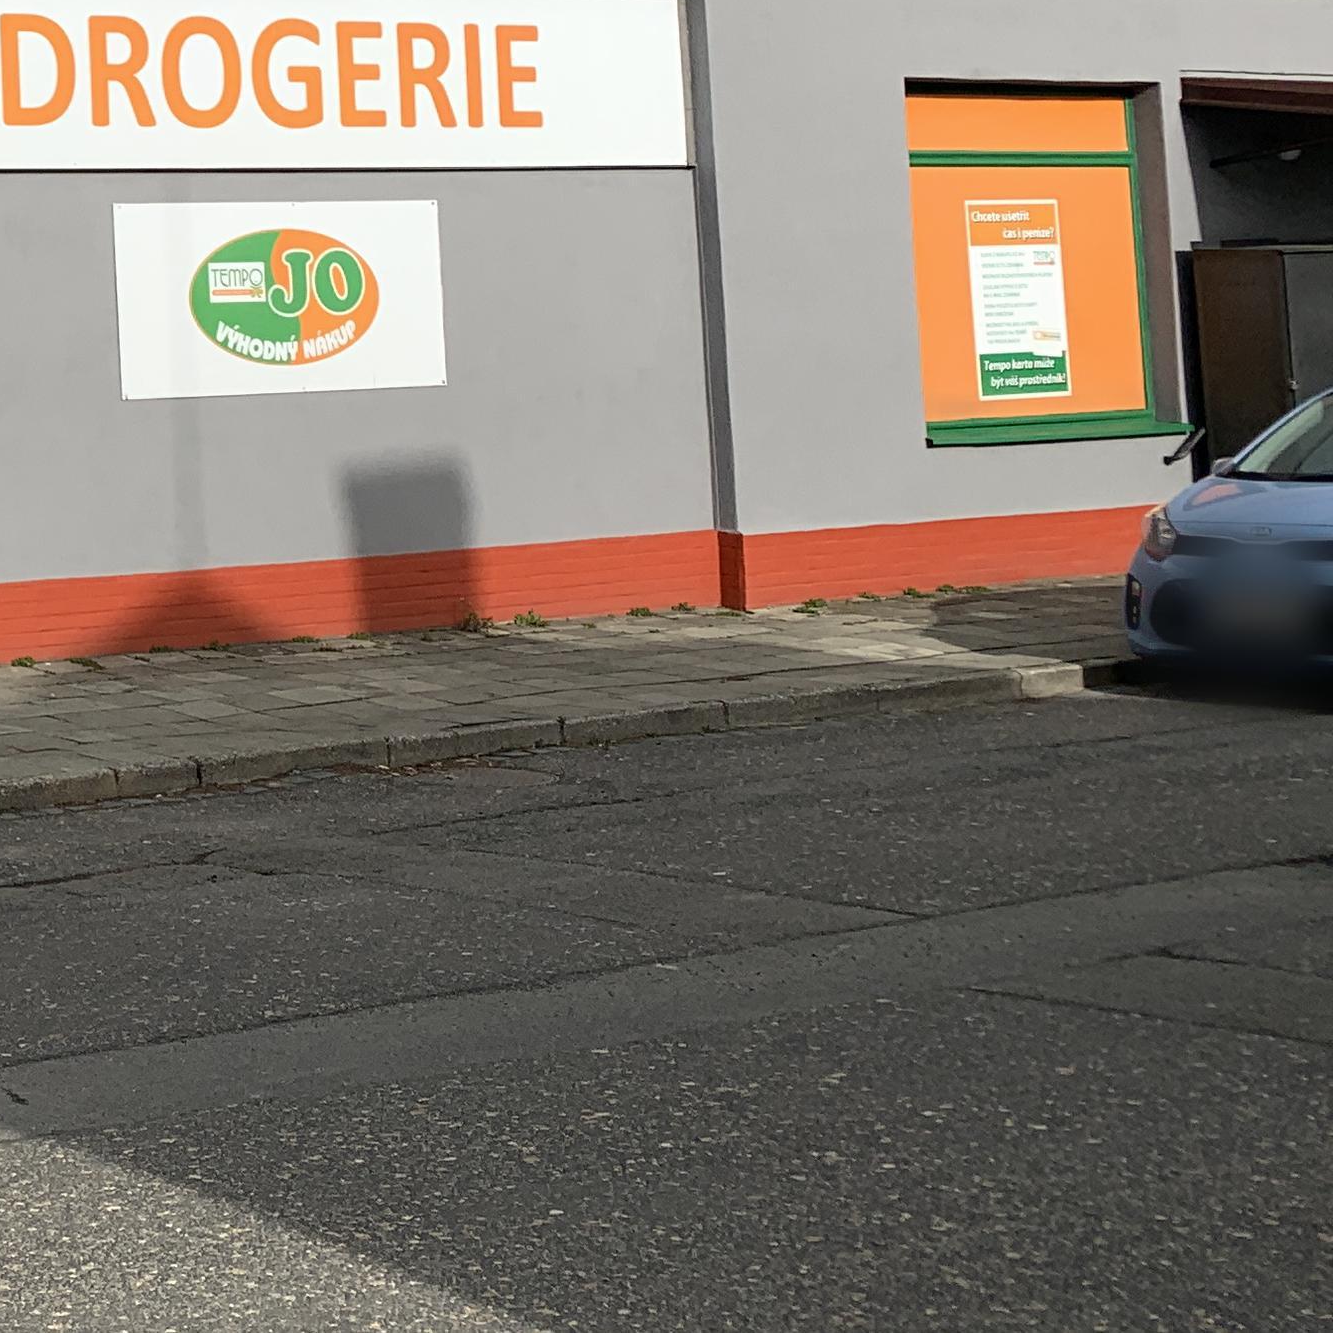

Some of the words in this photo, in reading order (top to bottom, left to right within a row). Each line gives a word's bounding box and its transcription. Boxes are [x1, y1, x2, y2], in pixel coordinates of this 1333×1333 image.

[0, 12, 544, 129] DROGERIE
[210, 268, 264, 288] TEMPO
[268, 246, 366, 318] JO
[215, 320, 299, 362] VÝHODNÝ
[302, 319, 357, 359] NÁKUP
[984, 360, 1011, 372] Tempo
[1012, 358, 1033, 370] karta
